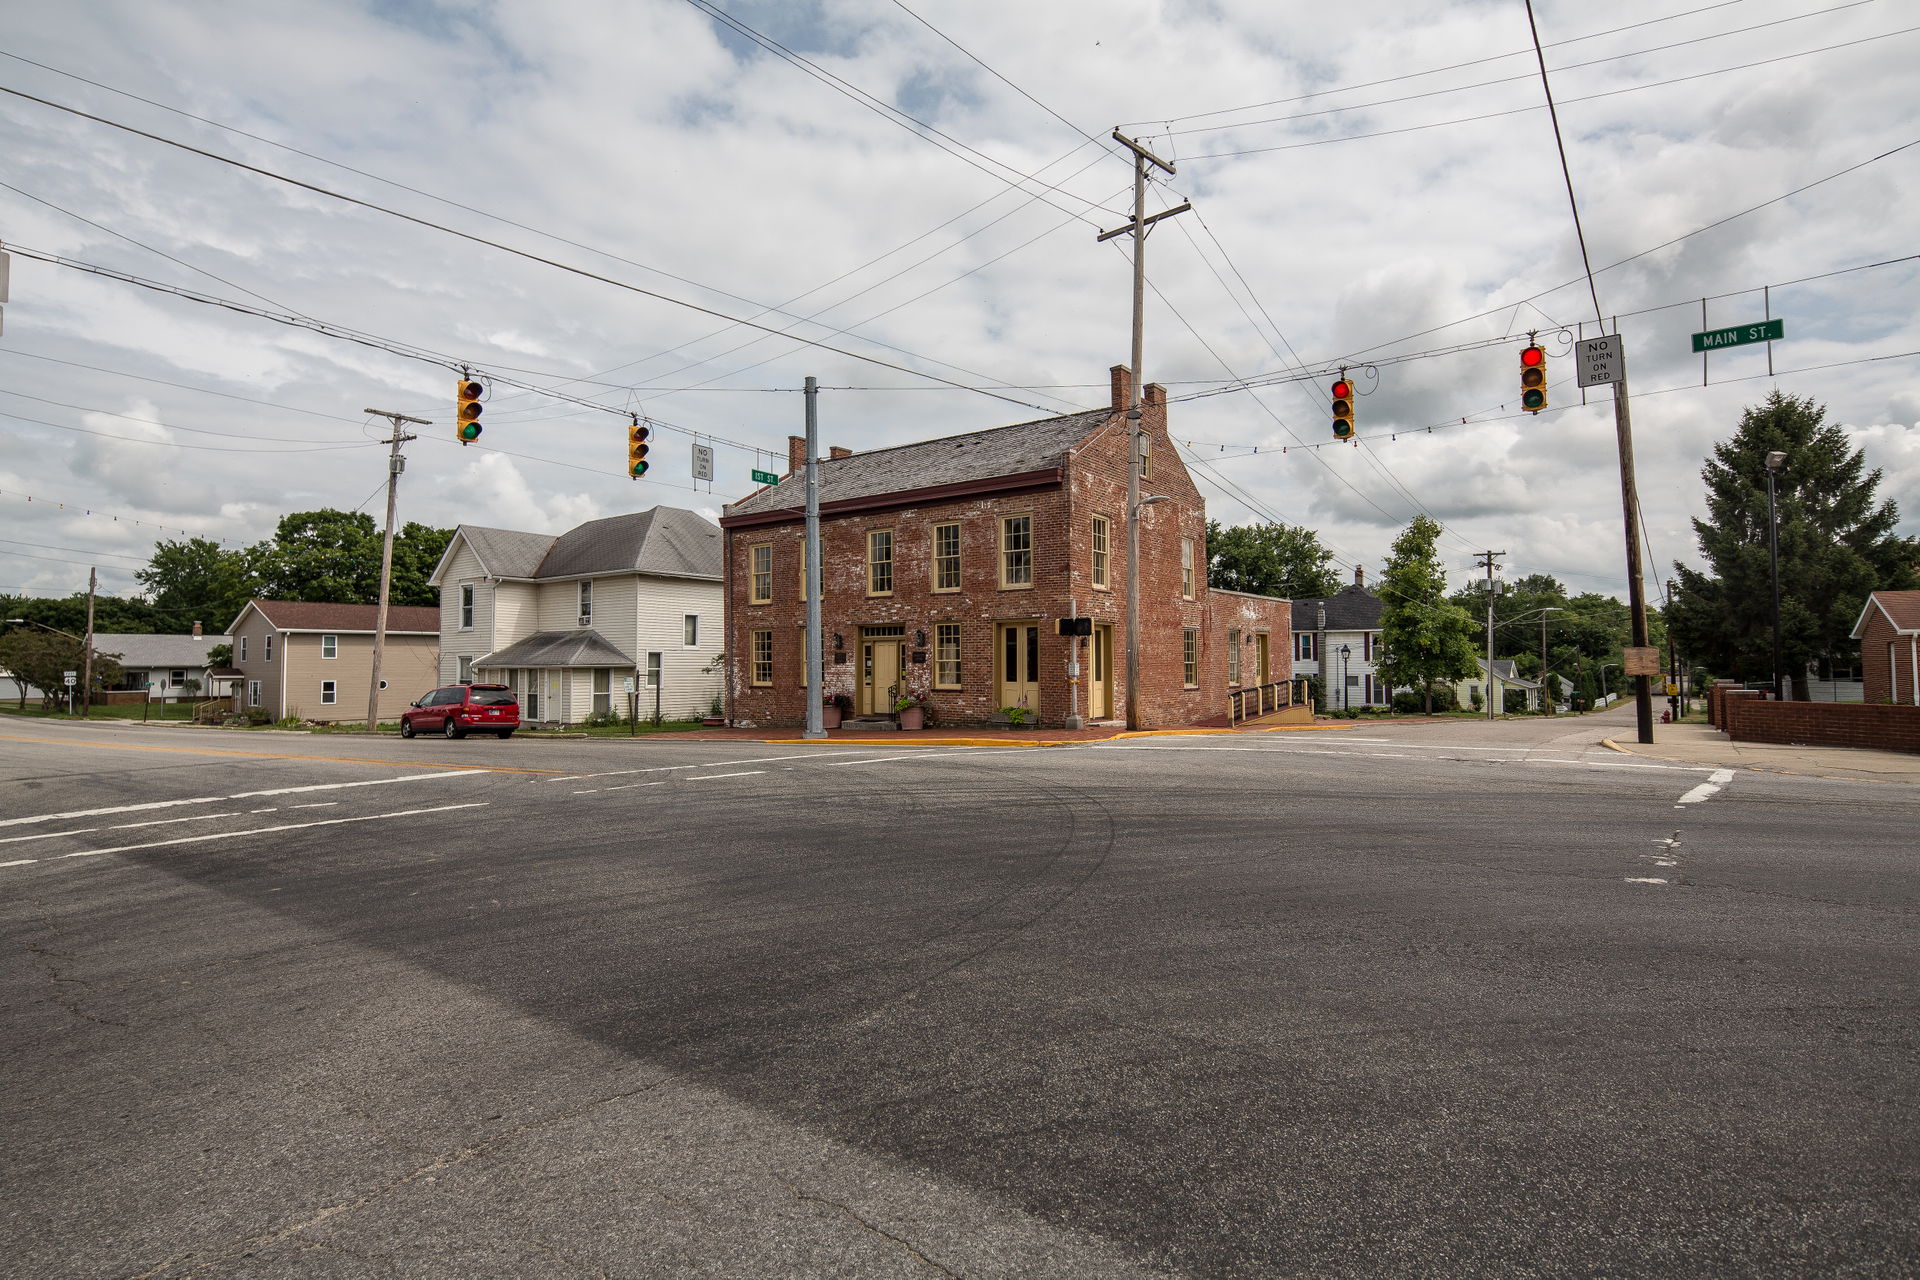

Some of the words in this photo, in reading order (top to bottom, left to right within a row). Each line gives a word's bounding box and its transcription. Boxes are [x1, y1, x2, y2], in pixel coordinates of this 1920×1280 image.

[1703, 331, 1737, 347] MAIN
[1749, 326, 1772, 340] ST.
[1588, 341, 1608, 353] NO
[1586, 352, 1613, 363] TURN
[1593, 363, 1607, 371] ON
[1590, 372, 1610, 382] RED
[698, 448, 708, 456] NO
